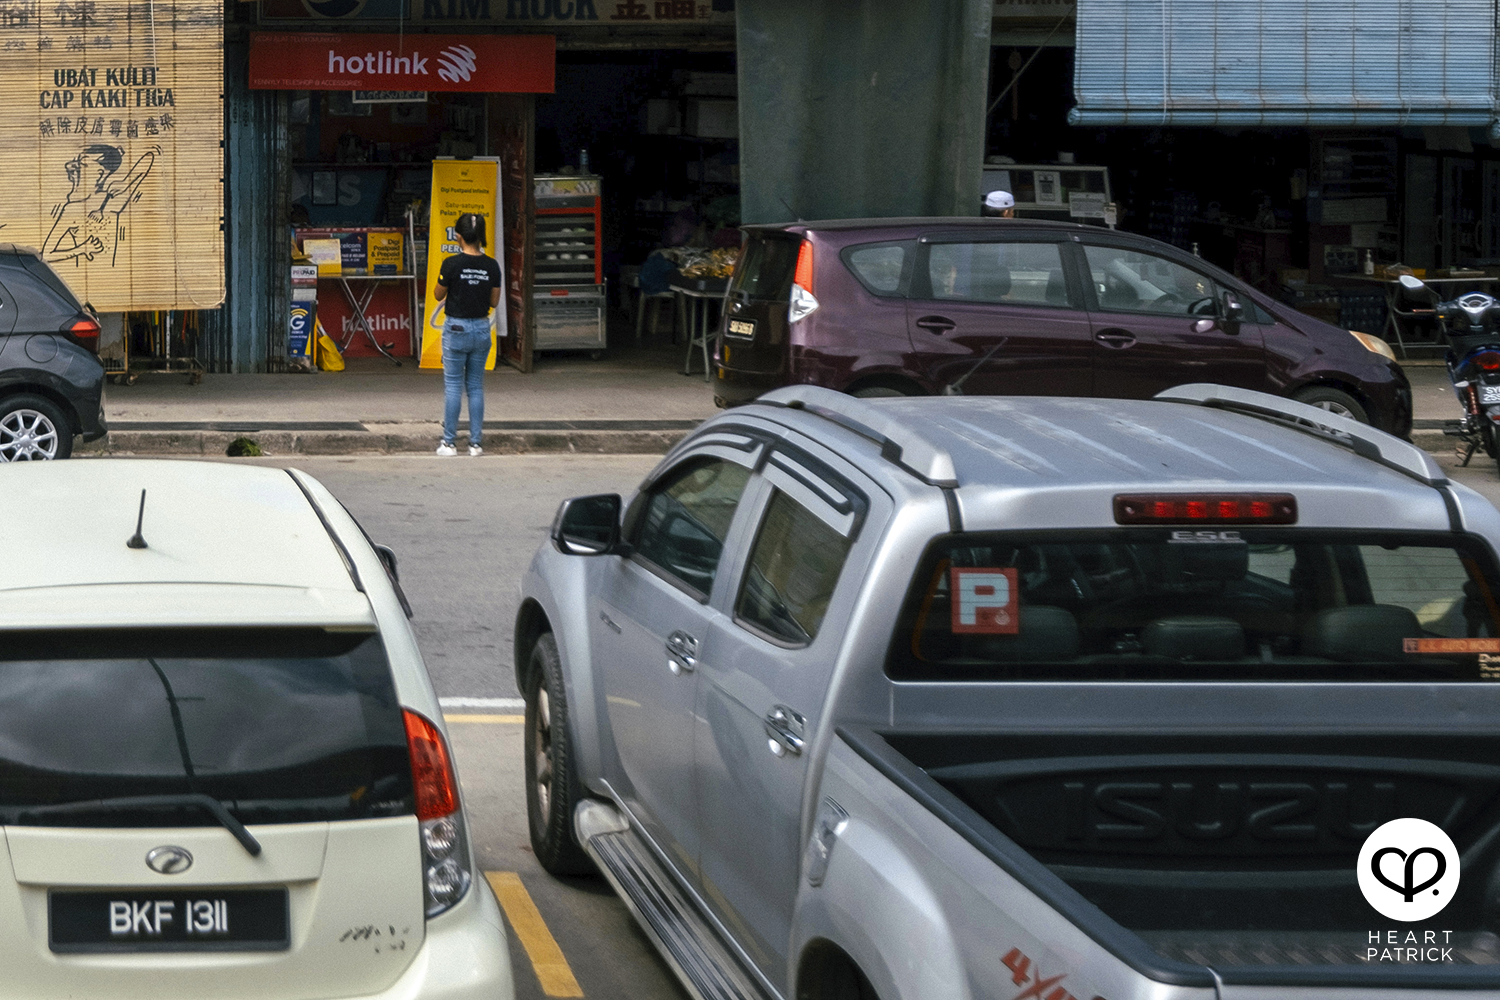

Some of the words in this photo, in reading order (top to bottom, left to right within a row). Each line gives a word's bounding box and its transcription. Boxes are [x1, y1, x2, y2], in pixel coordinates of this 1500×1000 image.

[328, 50, 430, 75] hotlink
[54, 68, 98, 87] UBAT
[106, 67, 159, 87] KULIT
[39, 89, 74, 109] CAP
[81, 89, 127, 108] KAKI
[134, 88, 175, 107] TIGA
[1171, 531, 1242, 540] ESC
[959, 573, 1009, 625] P
[109, 901, 175, 934] BKF
[186, 901, 228, 932] 1311
